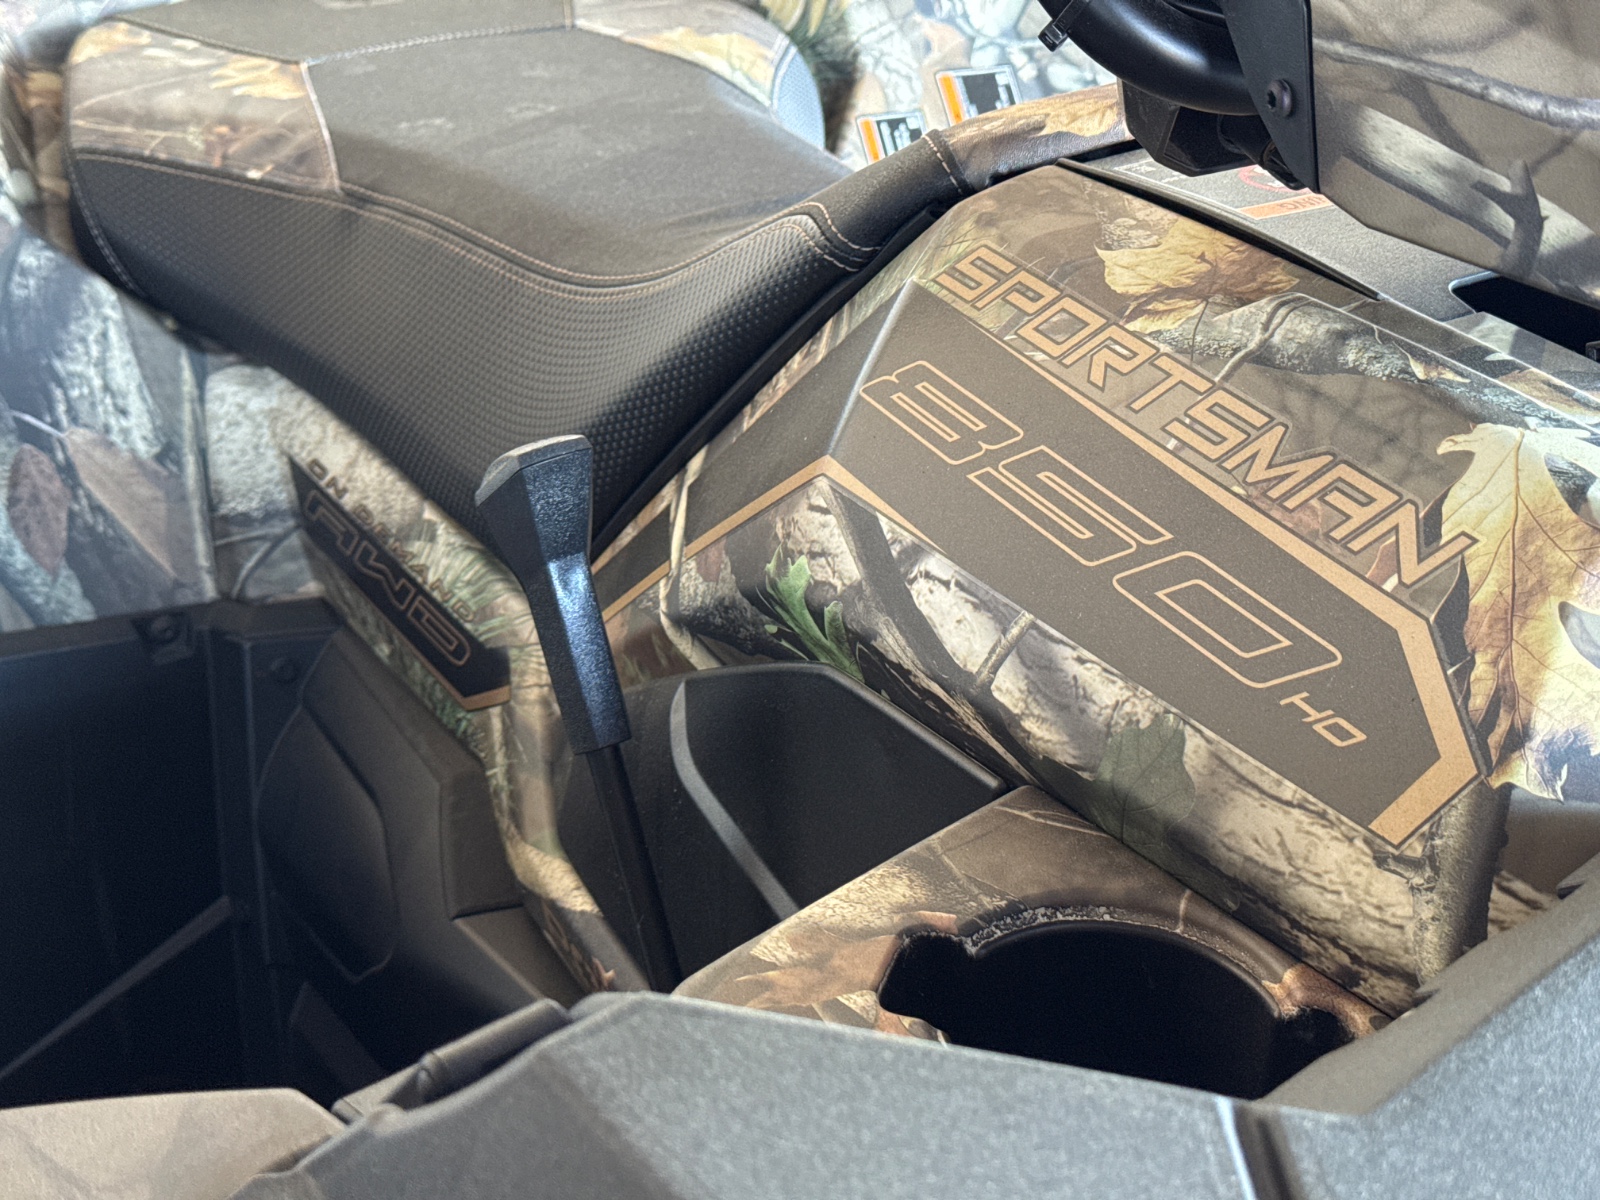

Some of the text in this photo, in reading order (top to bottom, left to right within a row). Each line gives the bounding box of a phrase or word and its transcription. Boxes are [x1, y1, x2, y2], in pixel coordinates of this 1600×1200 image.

[306, 458, 475, 622] ON DEMAND
[935, 244, 1479, 586] SPORTSMAN
[303, 489, 471, 667] AWD
[859, 360, 1368, 748] 850 HO
